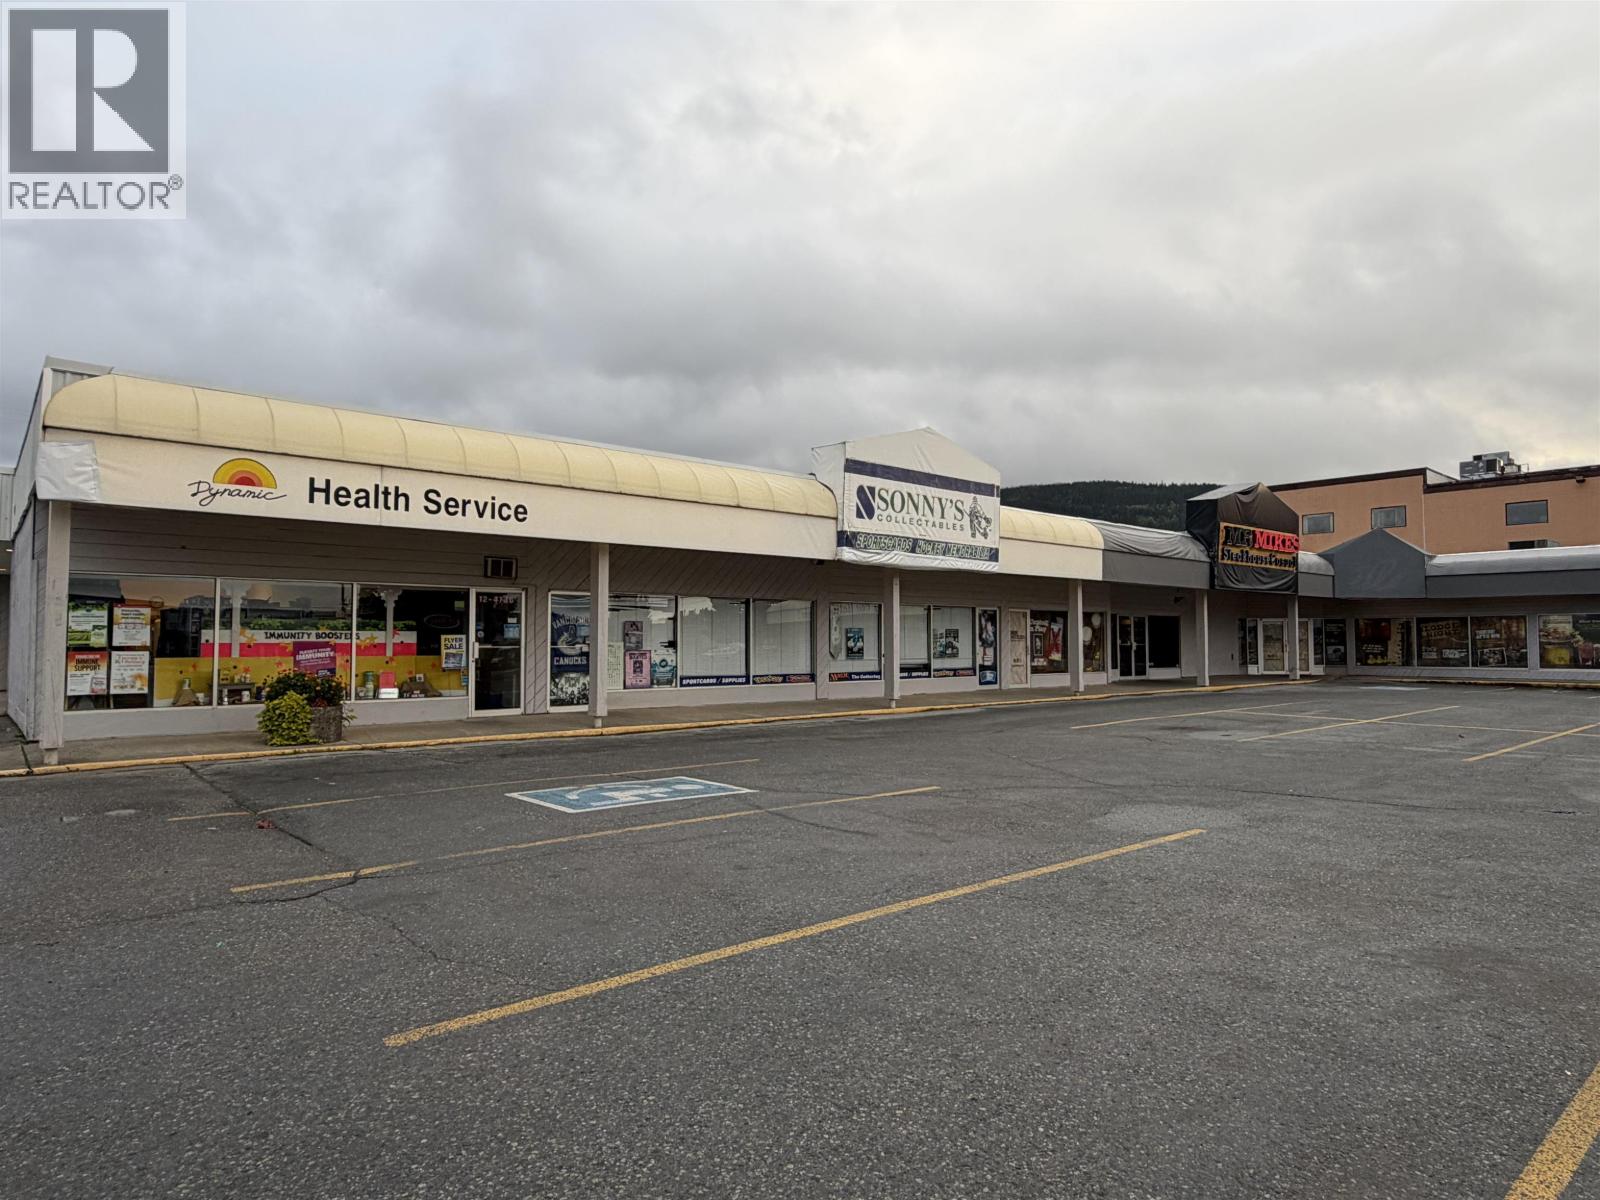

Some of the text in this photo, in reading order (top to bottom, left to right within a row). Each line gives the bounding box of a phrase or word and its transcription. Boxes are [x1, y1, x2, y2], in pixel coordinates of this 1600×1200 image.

[187, 479, 287, 506] Dynamic
[308, 477, 529, 523] Health Service
[877, 488, 964, 522] SONNY'S
[877, 513, 965, 531] COLLECTABLES
[915, 538, 945, 556] HOCKEY
[1254, 528, 1300, 553] MIKES
[264, 631, 360, 640] IMMUNITY BOOSTES
[296, 651, 335, 661] IMMUNITY
[554, 656, 588, 665] CANUCKS
[74, 664, 101, 672] SUPPORT
